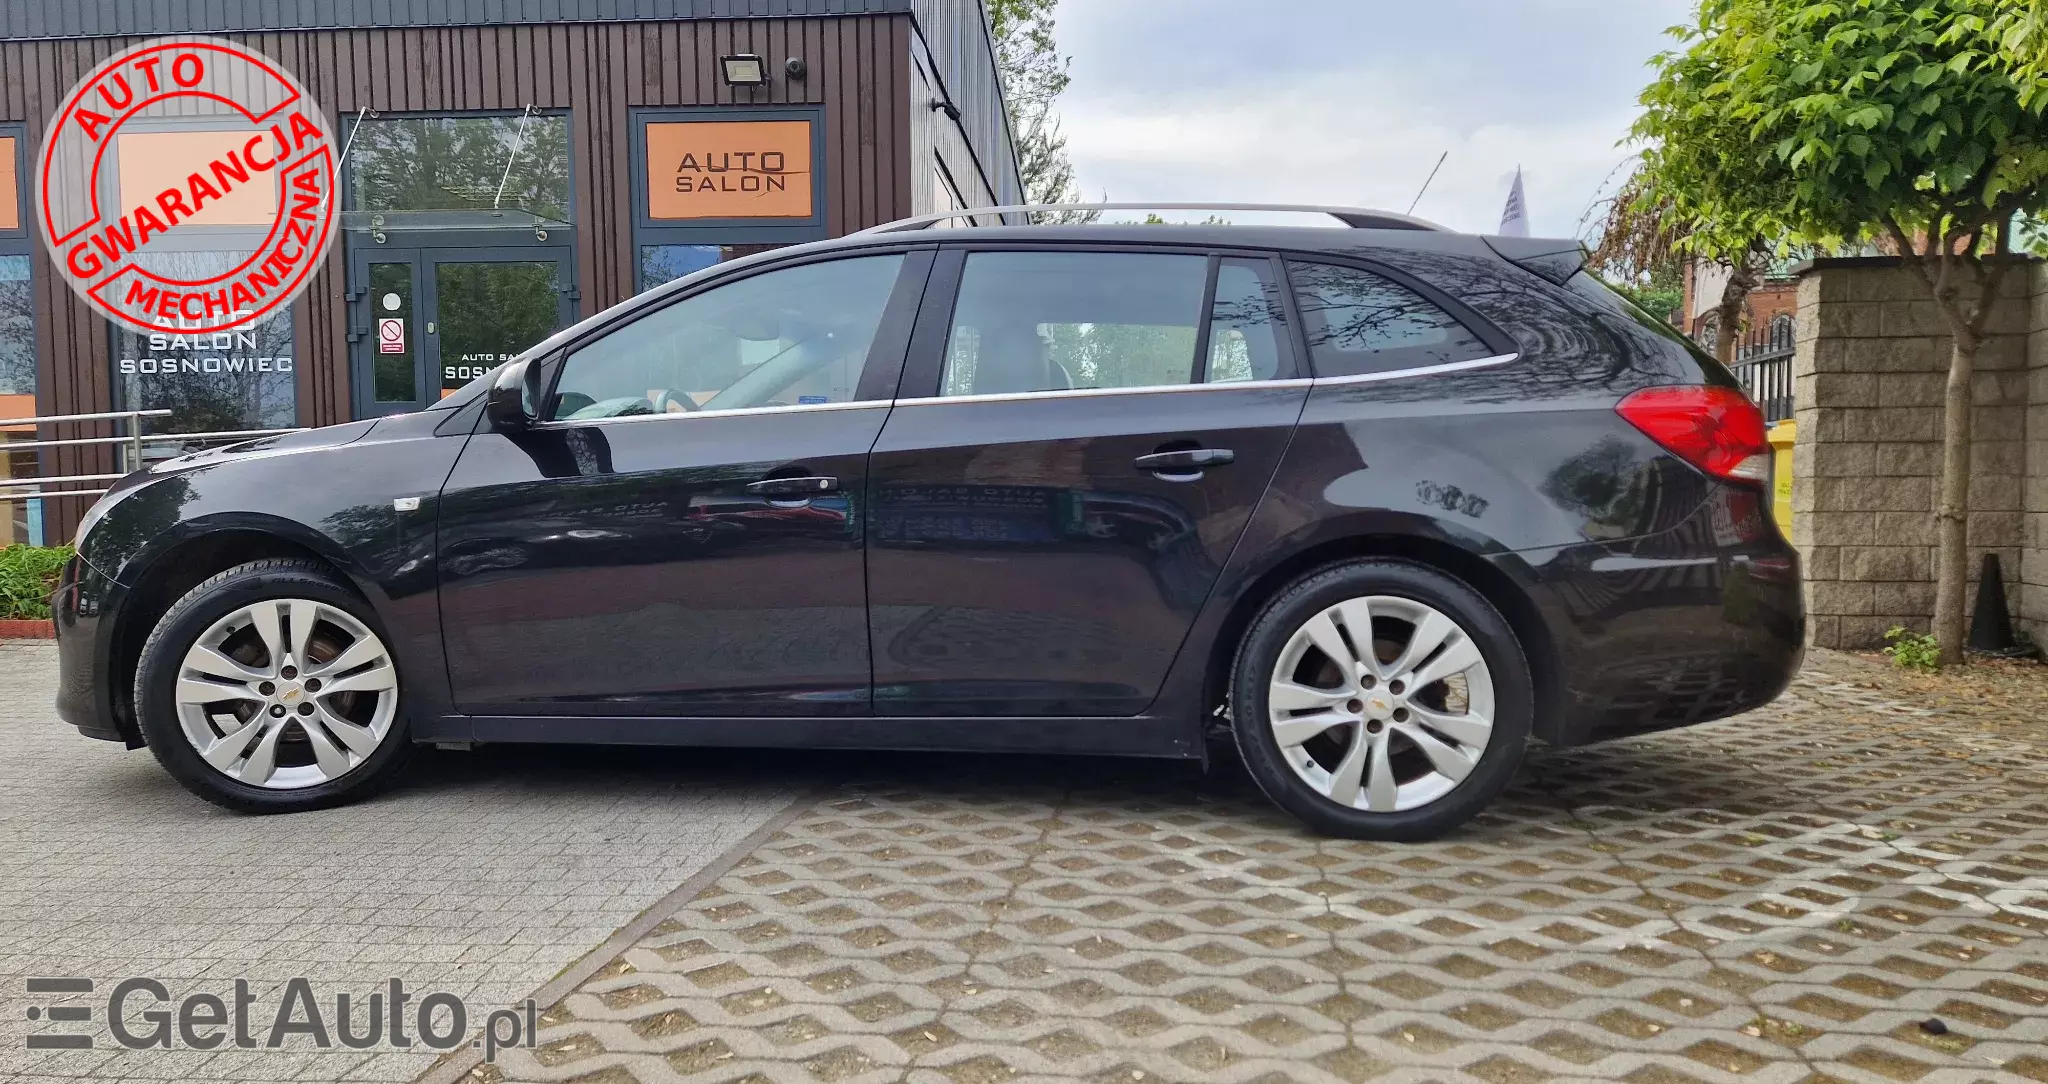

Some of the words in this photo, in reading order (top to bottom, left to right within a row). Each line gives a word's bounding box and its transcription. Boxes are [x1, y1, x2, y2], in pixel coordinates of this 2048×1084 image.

[677, 152, 785, 173] AUTO
[676, 175, 785, 192] SALON
[150, 332, 257, 351] SALON
[120, 357, 293, 374] SOSNOWIEC
[461, 353, 494, 361] AUTO
